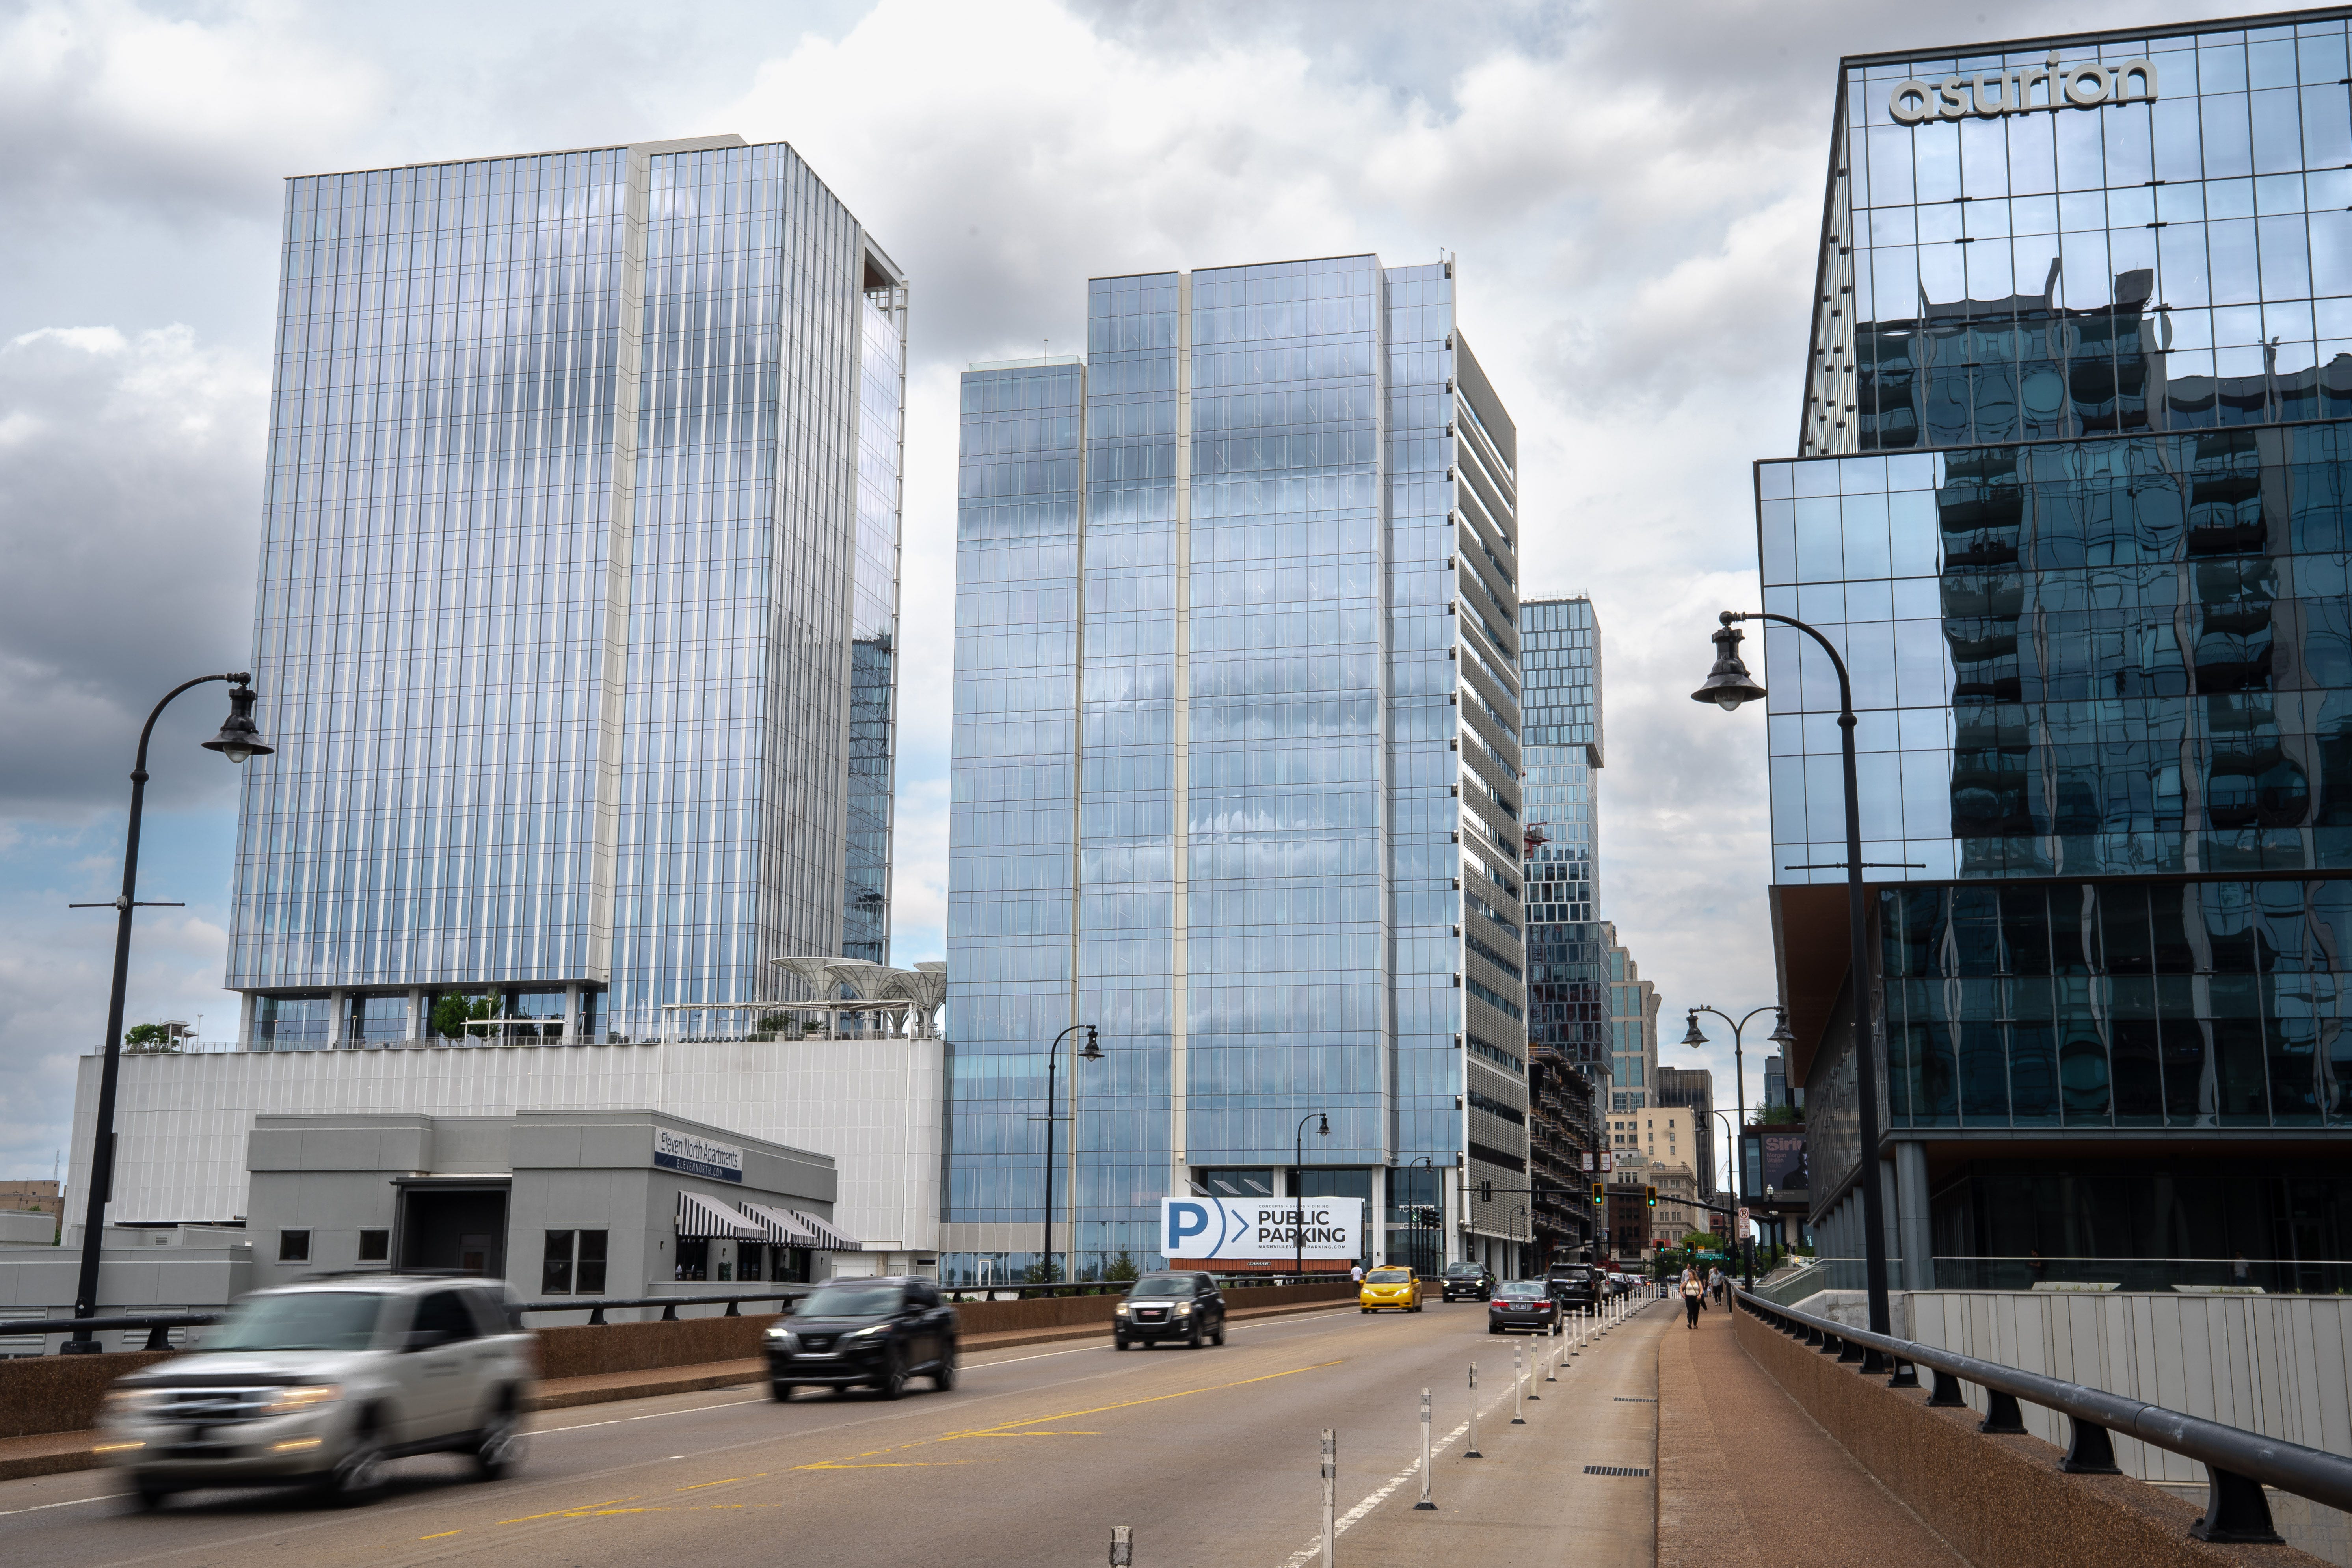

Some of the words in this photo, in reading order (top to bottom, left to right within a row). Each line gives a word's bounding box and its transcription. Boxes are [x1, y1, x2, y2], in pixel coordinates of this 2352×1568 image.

[1889, 50, 2158, 122] asurion
[661, 1132, 682, 1155] Eleven
[684, 1138, 702, 1159] North
[703, 1144, 738, 1168] Apartments
[677, 1159, 723, 1177] ELEVENNORTH.COM
[1169, 1202, 1208, 1249] P
[1258, 1210, 1330, 1225] PUBLIC
[1258, 1228, 1345, 1242] PARKING
